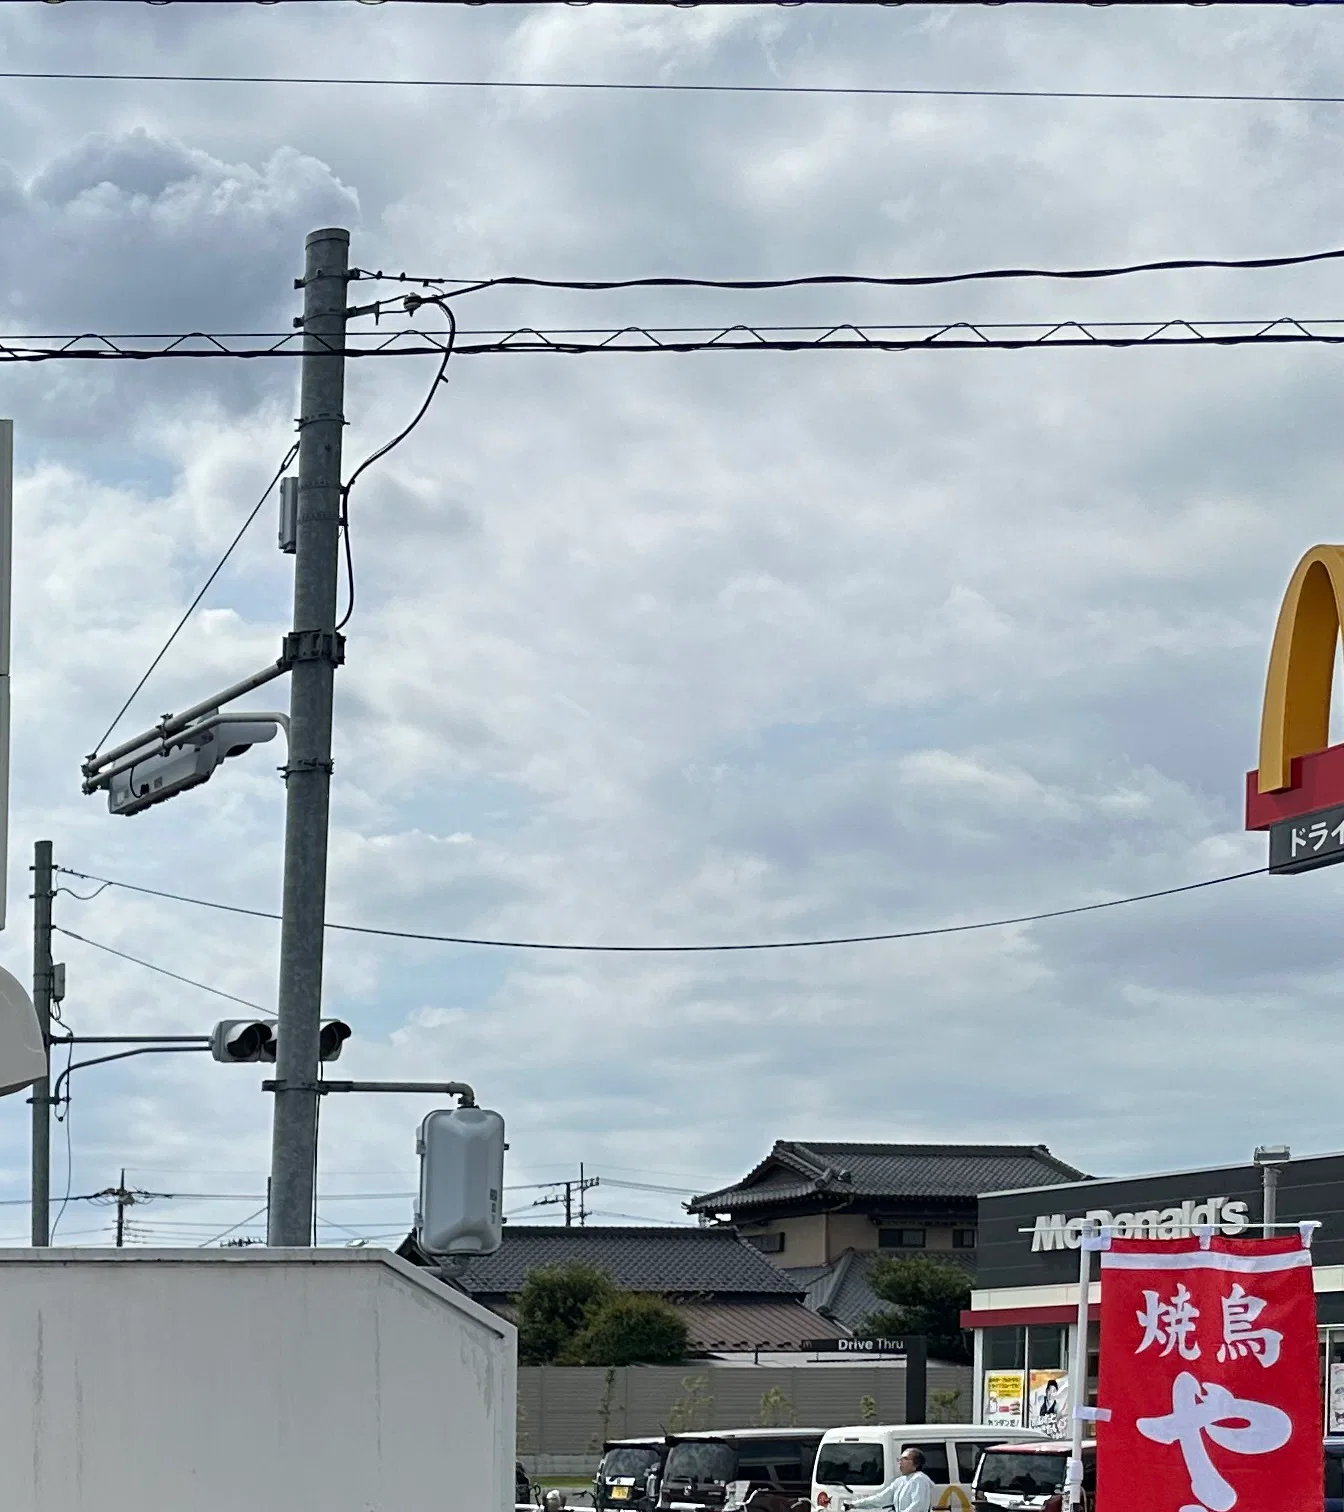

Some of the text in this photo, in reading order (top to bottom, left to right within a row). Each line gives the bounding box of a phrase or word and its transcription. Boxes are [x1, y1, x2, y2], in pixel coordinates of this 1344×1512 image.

[838, 1338, 905, 1350] Drive Thru
[1134, 1283, 1284, 1369] 焼鳥
